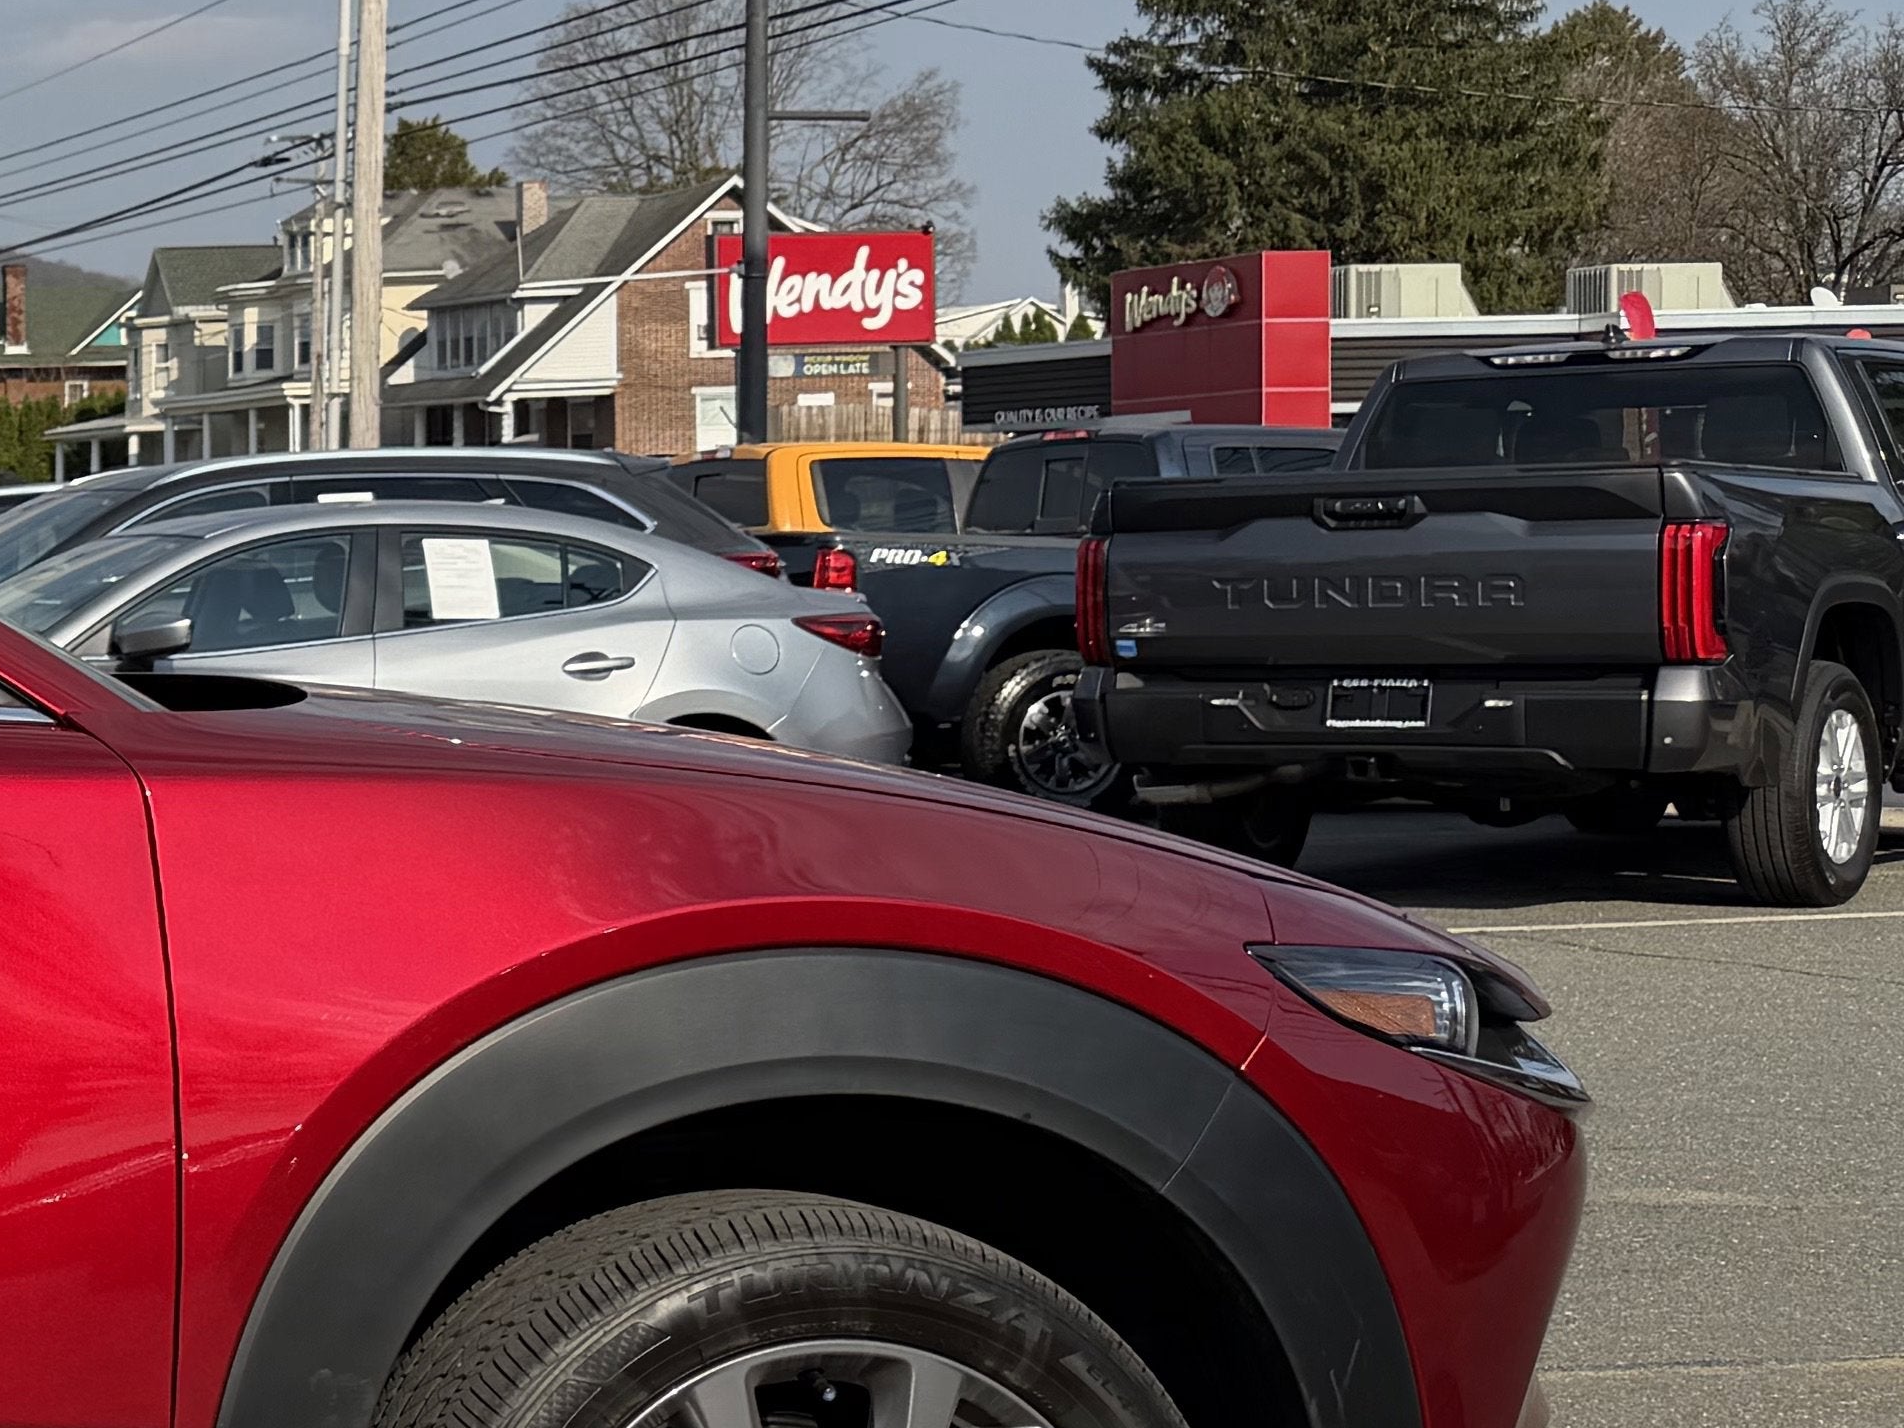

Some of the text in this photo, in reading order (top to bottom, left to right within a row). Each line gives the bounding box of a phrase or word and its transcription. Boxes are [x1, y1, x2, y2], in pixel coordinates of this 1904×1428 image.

[1125, 276, 1197, 333] Wendy's
[803, 362, 870, 375] OPEN LATE
[1212, 575, 1525, 609] TUNDRA
